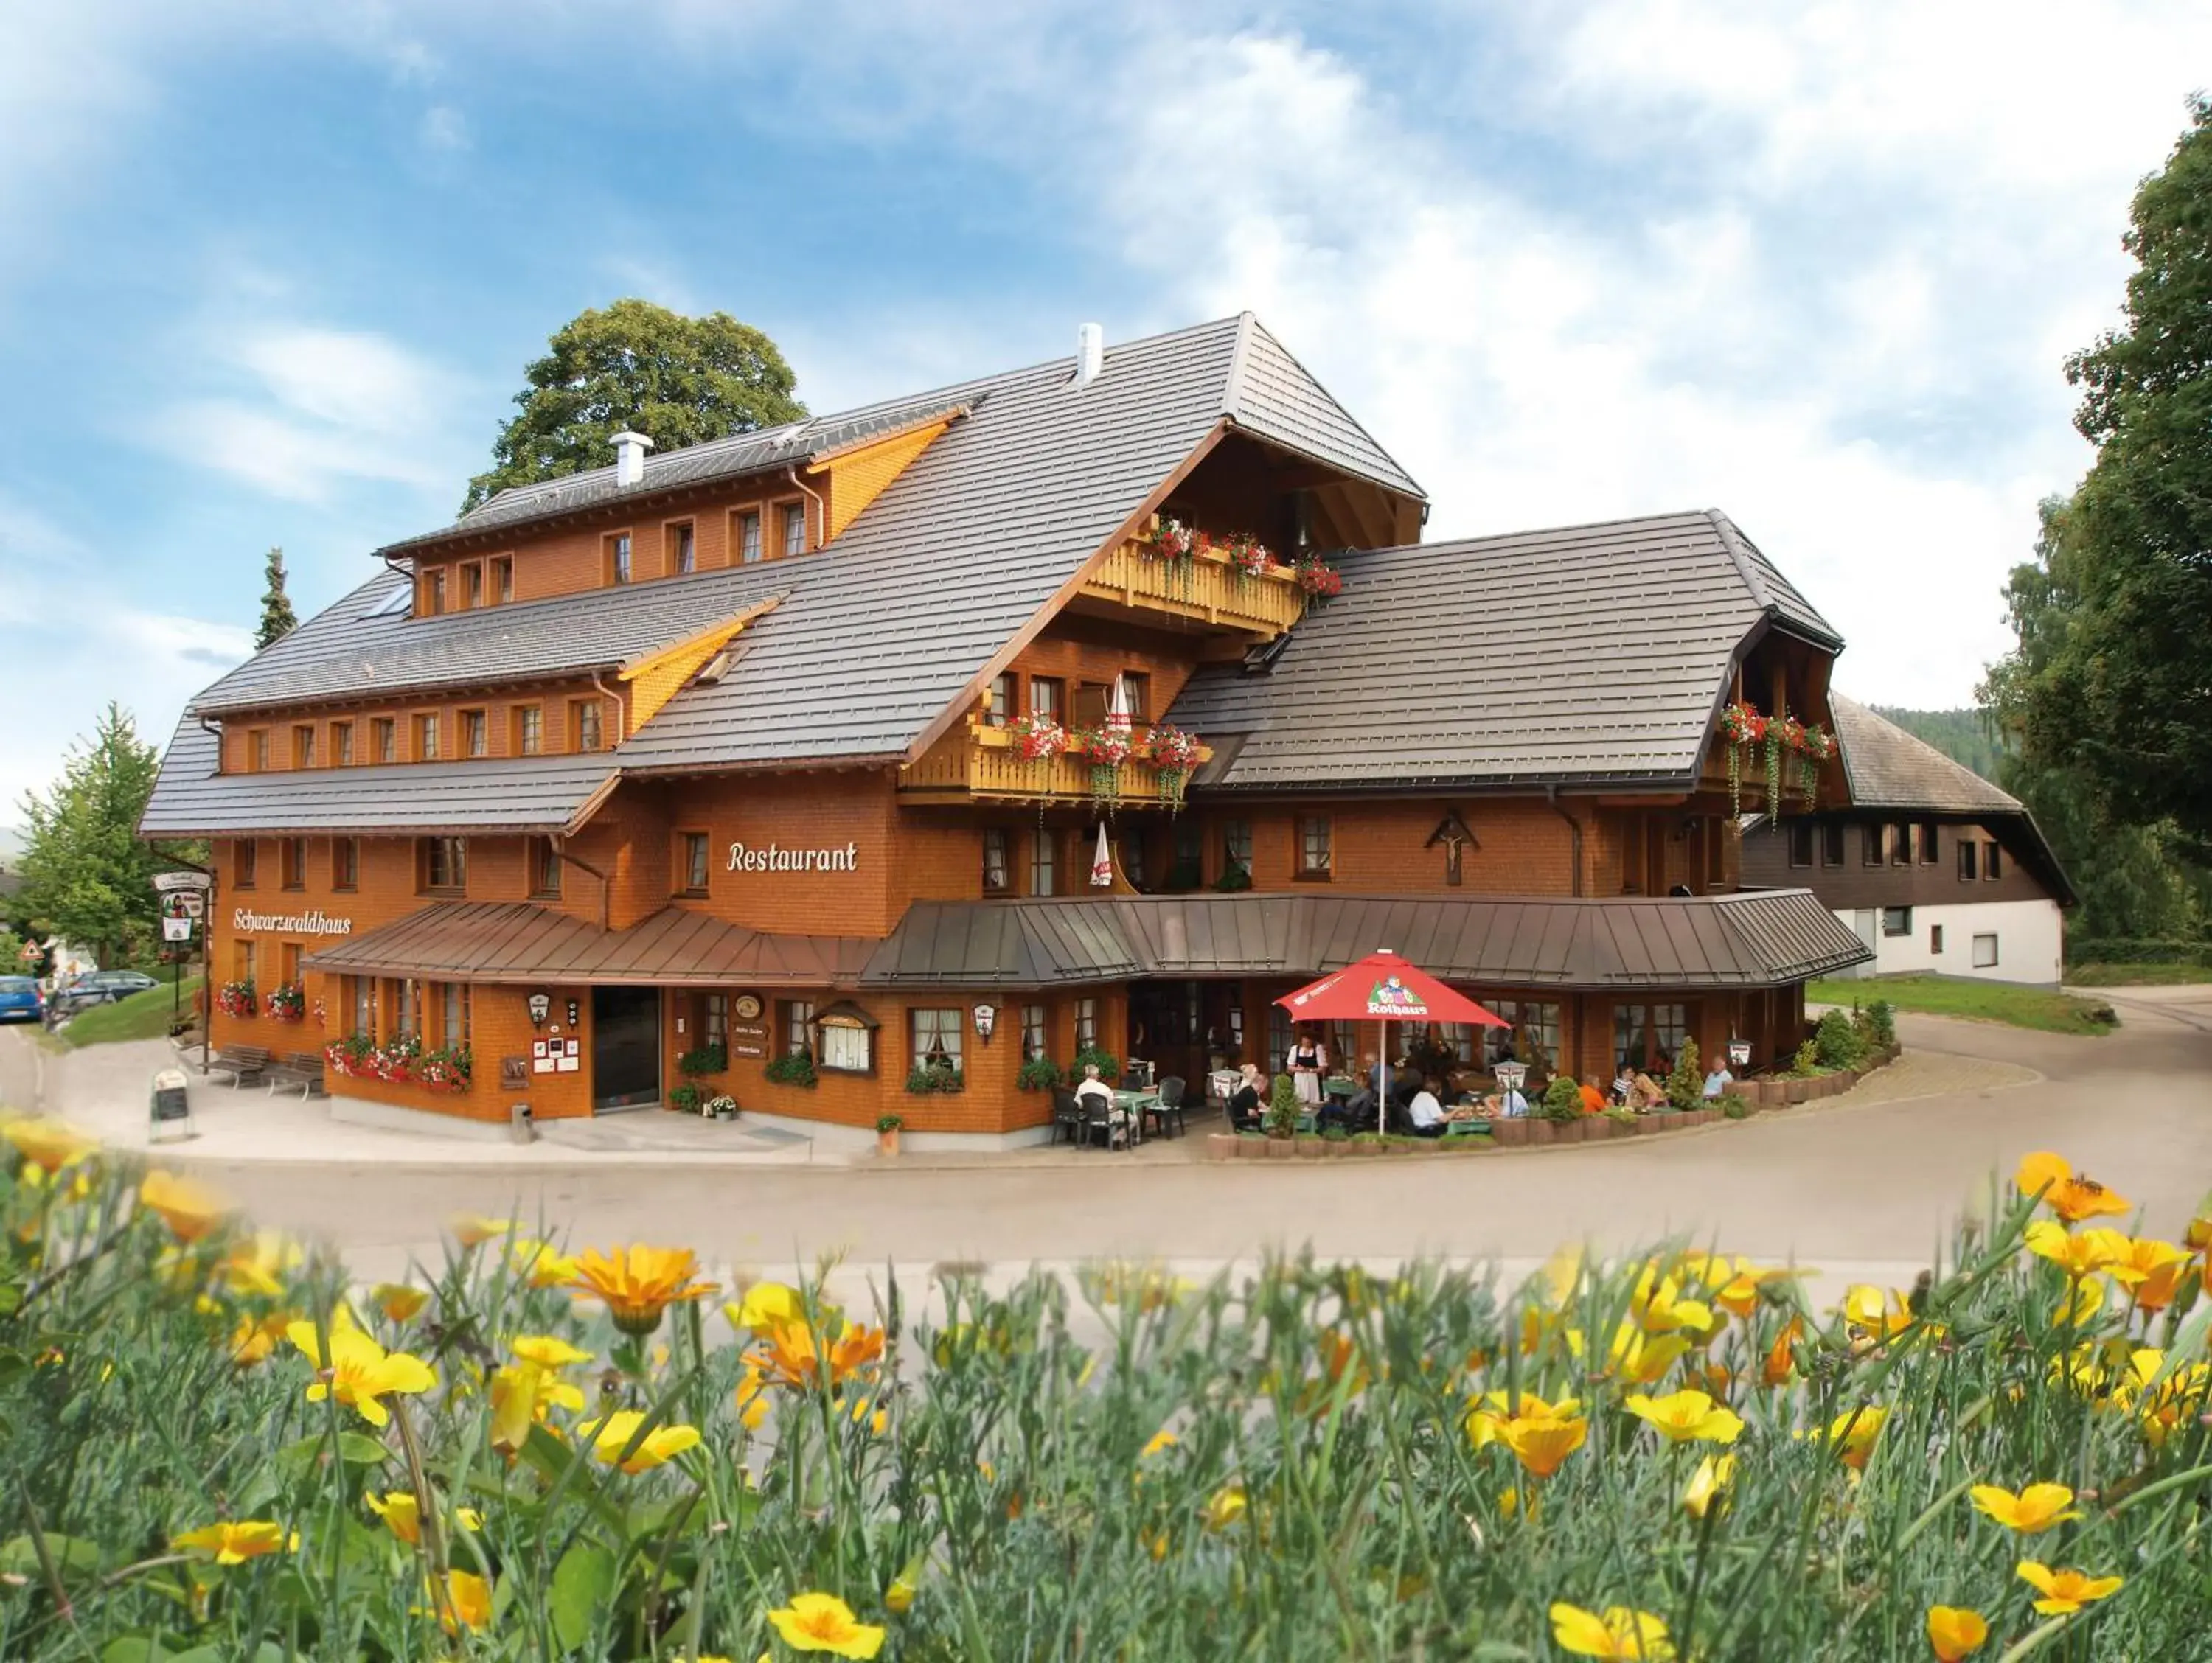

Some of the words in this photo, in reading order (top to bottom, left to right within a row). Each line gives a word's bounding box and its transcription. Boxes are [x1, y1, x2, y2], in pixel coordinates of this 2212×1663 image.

[726, 841, 858, 871] Restaurant
[234, 907, 352, 937] Schwarzwaldhaus
[1367, 1002, 1427, 1015] Rothaus
